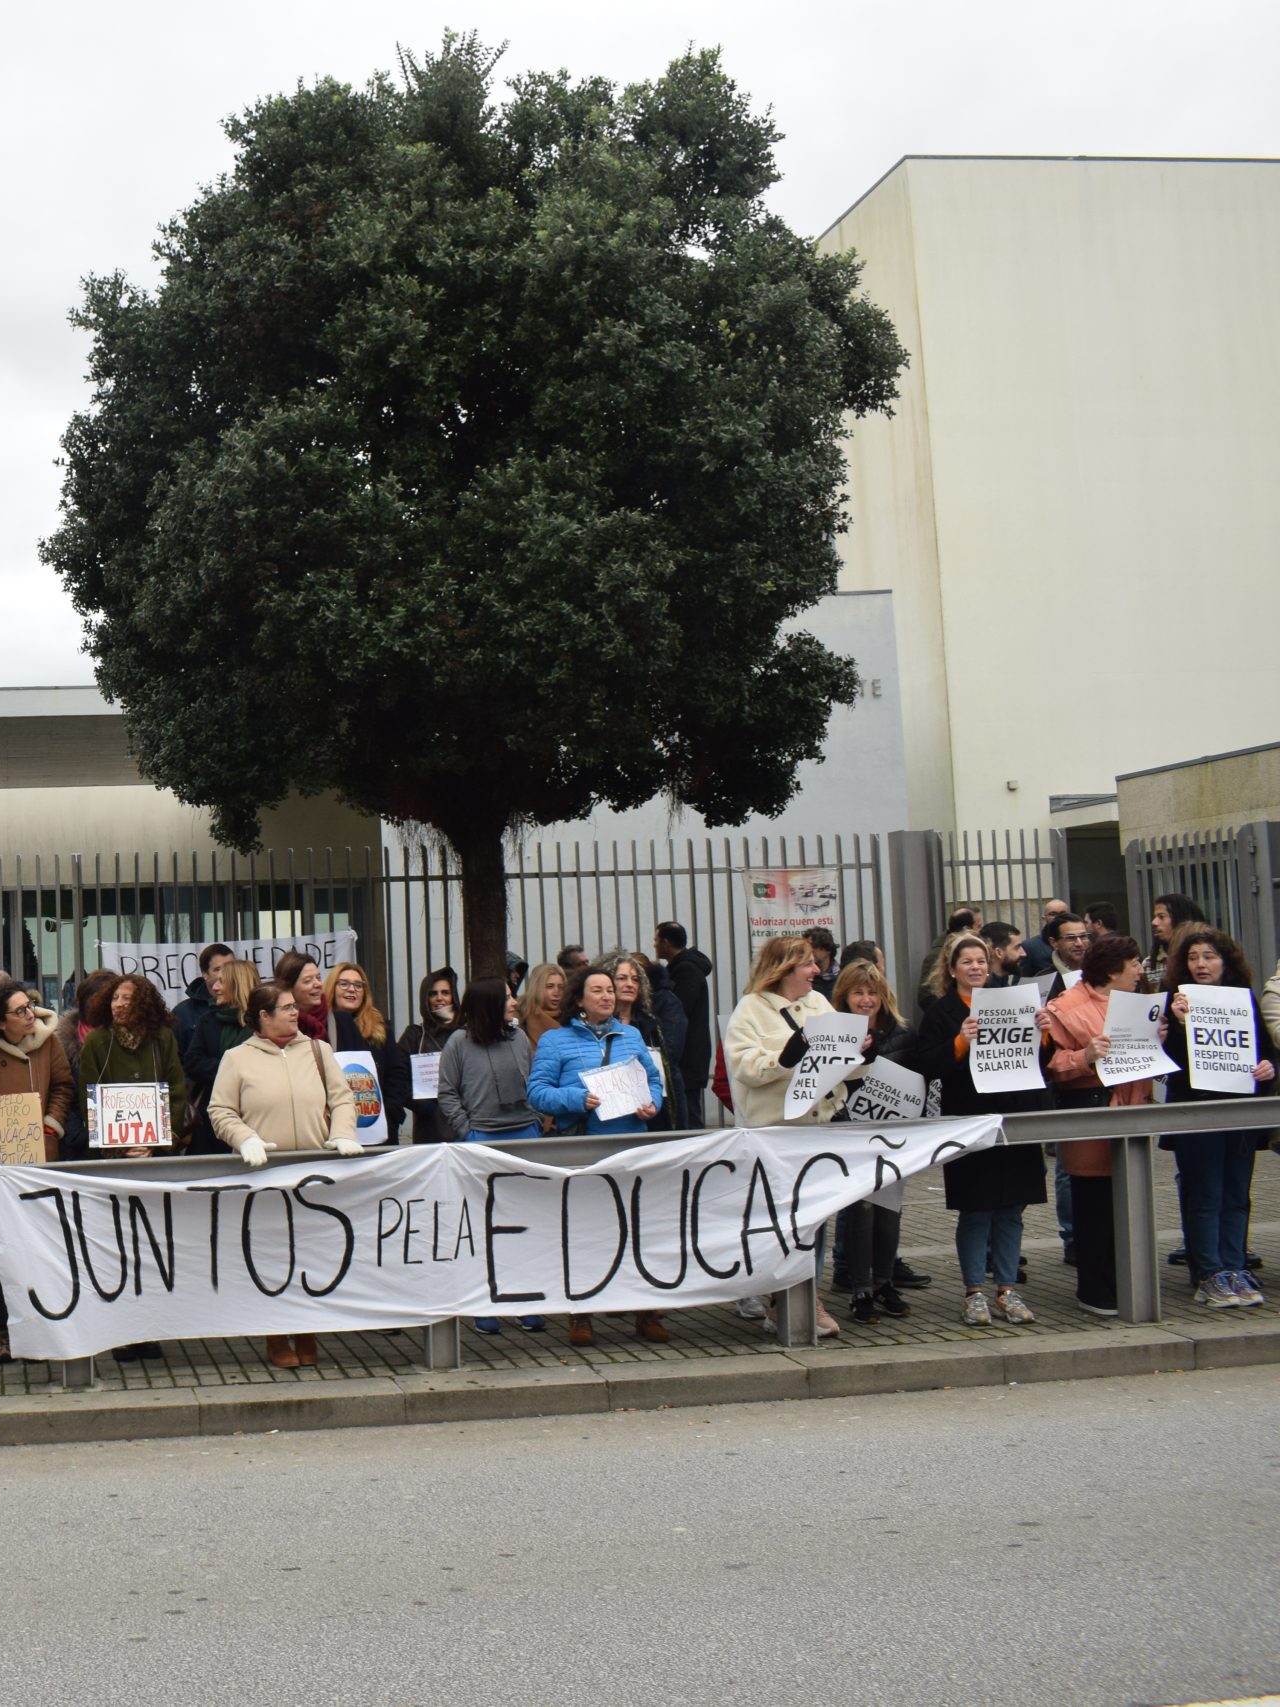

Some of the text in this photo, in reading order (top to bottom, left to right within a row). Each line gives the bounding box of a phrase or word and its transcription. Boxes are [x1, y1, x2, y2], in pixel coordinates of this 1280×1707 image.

[790, 918, 815, 928] quem
[978, 1006, 1036, 1017] PESSOAL NÃO
[1190, 1006, 1248, 1017] PESSOAL NÃO
[976, 1017, 1018, 1025] DOCENTE
[1190, 1015, 1231, 1025] DOCENTE
[838, 1034, 858, 1044] NÃO
[976, 1027, 1034, 1045] EXIGE
[1193, 1027, 1250, 1049] EXIGE
[976, 1047, 1034, 1060] MELHORIA
[1194, 1049, 1239, 1061] RESPEITO
[977, 1059, 1028, 1073] SALARIAL
[1102, 1055, 1157, 1065] 36 ANOS DE
[1195, 1060, 1255, 1074] E DIGNIDADE
[864, 1075, 902, 1099] PESSOAL
[903, 1092, 921, 1106] NÃO
[0, 1093, 24, 1107] PELO
[101, 1088, 157, 1110] PROFESSORES
[6, 1117, 19, 1127] DA
[115, 1110, 142, 1122] EM
[108, 1122, 157, 1145] LUTA
[0, 1143, 30, 1153] E DE
[19, 1174, 354, 1320] JUNTOS
[377, 1196, 476, 1267] PELA
